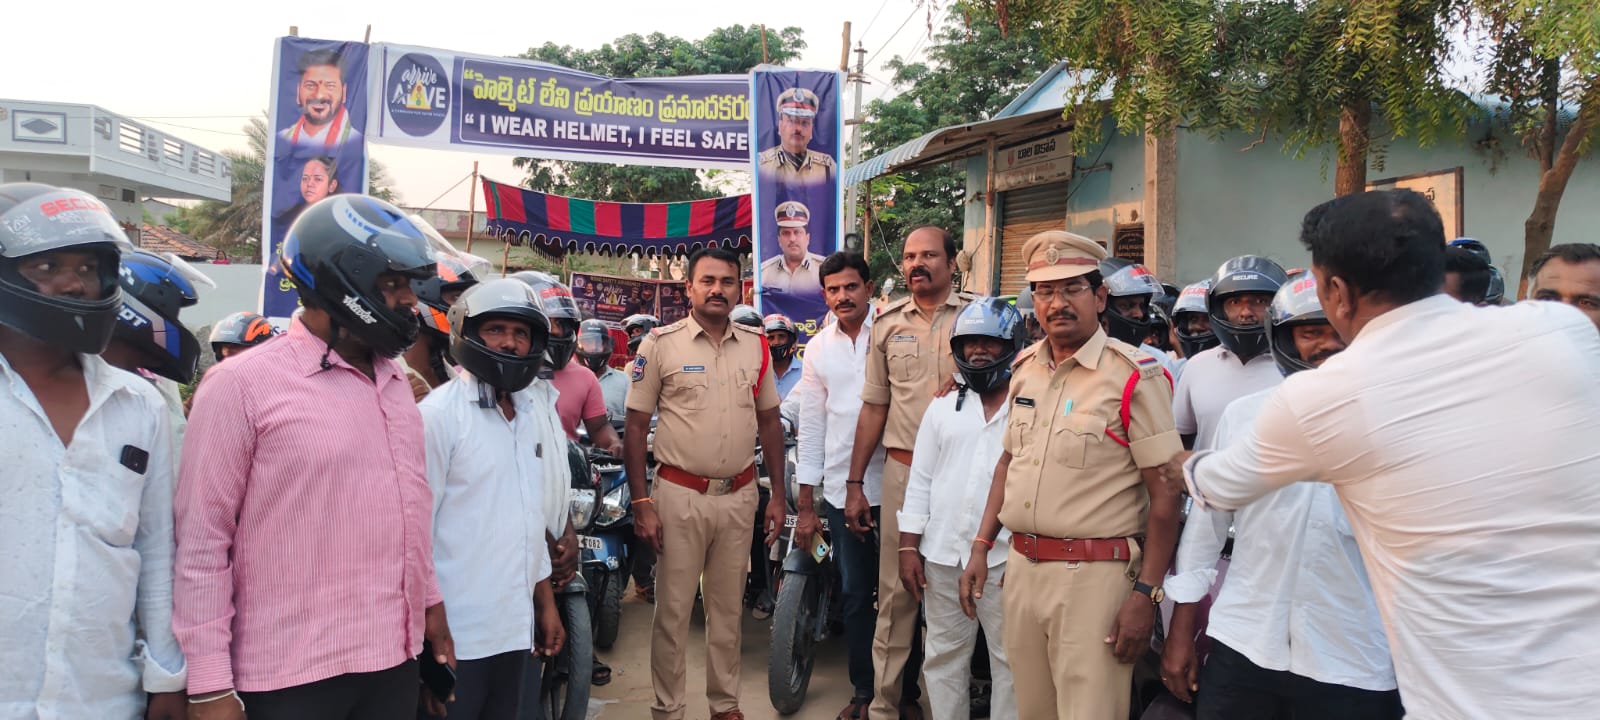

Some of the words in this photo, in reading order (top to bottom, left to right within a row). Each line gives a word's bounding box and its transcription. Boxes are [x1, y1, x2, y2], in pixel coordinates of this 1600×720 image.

[540, 77, 571, 109] లేని
[480, 114, 485, 133] I
[492, 115, 548, 138] WEAR
[553, 119, 632, 147] HELMET,
[639, 126, 645, 145] I
[651, 128, 696, 148] FEEL
[701, 130, 748, 151] SAFE
